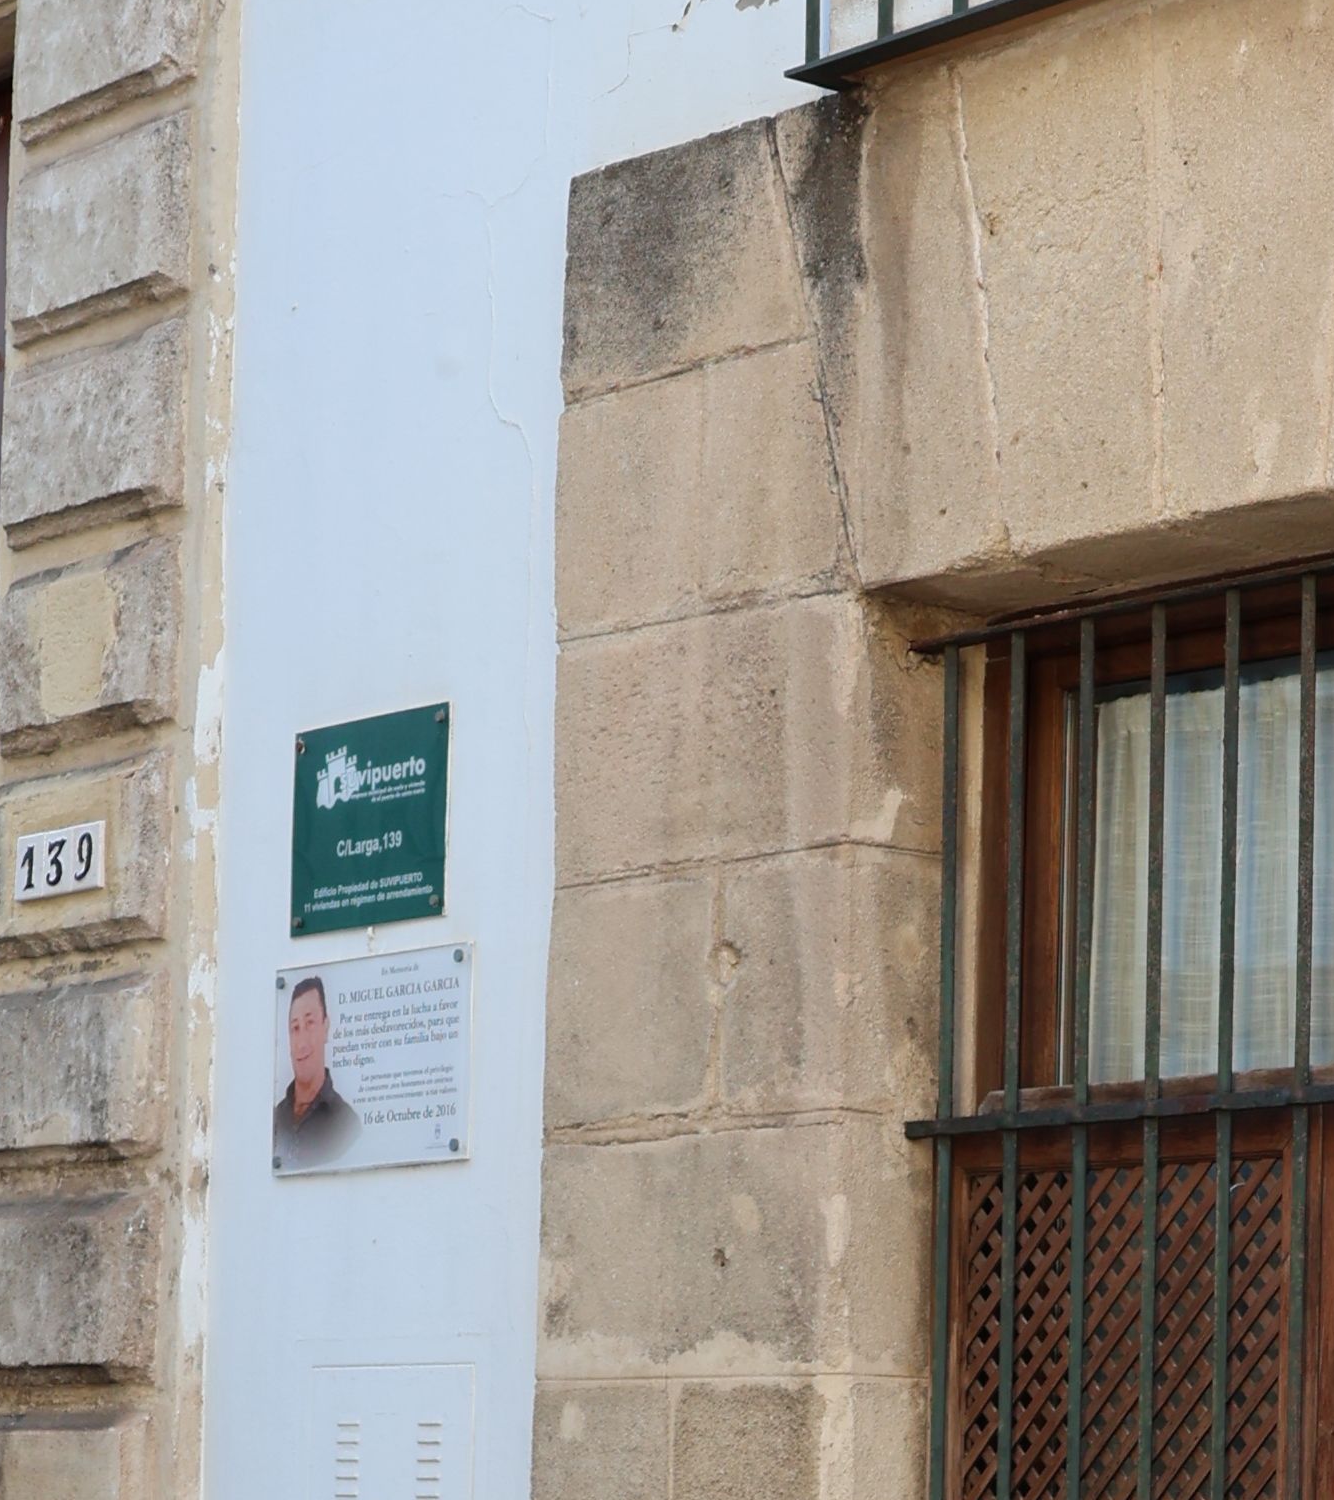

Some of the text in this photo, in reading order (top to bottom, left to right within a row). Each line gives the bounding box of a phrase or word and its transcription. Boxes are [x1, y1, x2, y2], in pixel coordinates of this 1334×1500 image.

[340, 756, 425, 791] suvipuerto
[21, 832, 93, 890] 139
[314, 872, 423, 899] Edificio Propiedad de SUVIPUERTO
[304, 904, 311, 913] 11
[312, 898, 340, 911] viviendas
[341, 898, 349, 907] en
[377, 892, 385, 901] de
[386, 885, 433, 900] arrendamiento
[339, 993, 348, 1004] D.
[350, 988, 384, 1004] MIGUEL
[340, 1014, 353, 1024] Por
[364, 1010, 390, 1022] entrega
[403, 1004, 409, 1015] la
[411, 1003, 431, 1014] lucha
[439, 999, 458, 1011] favor
[333, 1028, 341, 1039] de
[344, 1026, 353, 1037] los
[372, 1019, 425, 1034] desfavorecidos,
[428, 1017, 443, 1029] para
[446, 1016, 459, 1026] que
[333, 1042, 359, 1056] puedan
[361, 1038, 377, 1050] vivir
[379, 1038, 392, 1048] con
[404, 1033, 429, 1044] familia
[431, 1030, 446, 1043] bajo
[449, 1031, 458, 1039] un
[332, 1057, 351, 1067] techo
[364, 1103, 456, 1124] 16 de Octubre de 2016
